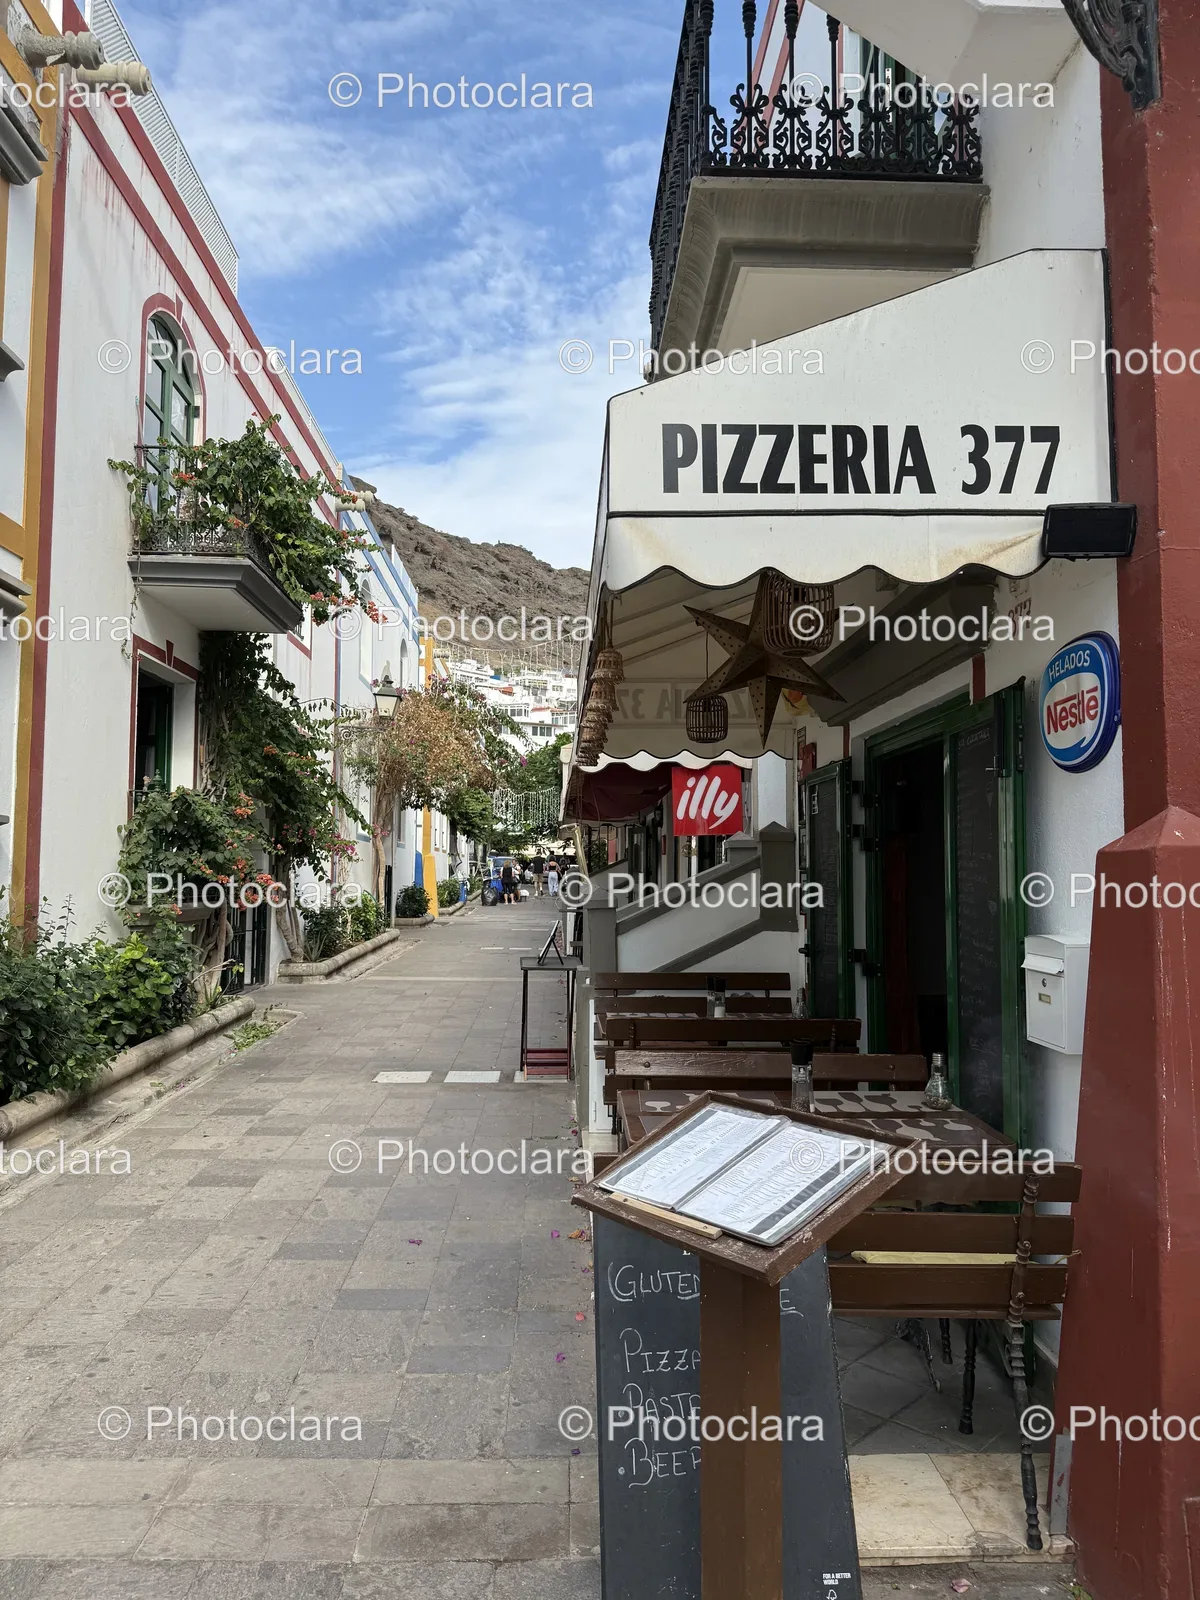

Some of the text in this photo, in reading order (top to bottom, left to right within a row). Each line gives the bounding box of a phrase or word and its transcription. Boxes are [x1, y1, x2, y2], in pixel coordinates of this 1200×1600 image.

[661, 423, 1061, 495] PIZZERIA 377
[1048, 649, 1091, 683] HELADOS
[676, 774, 740, 830] illy
